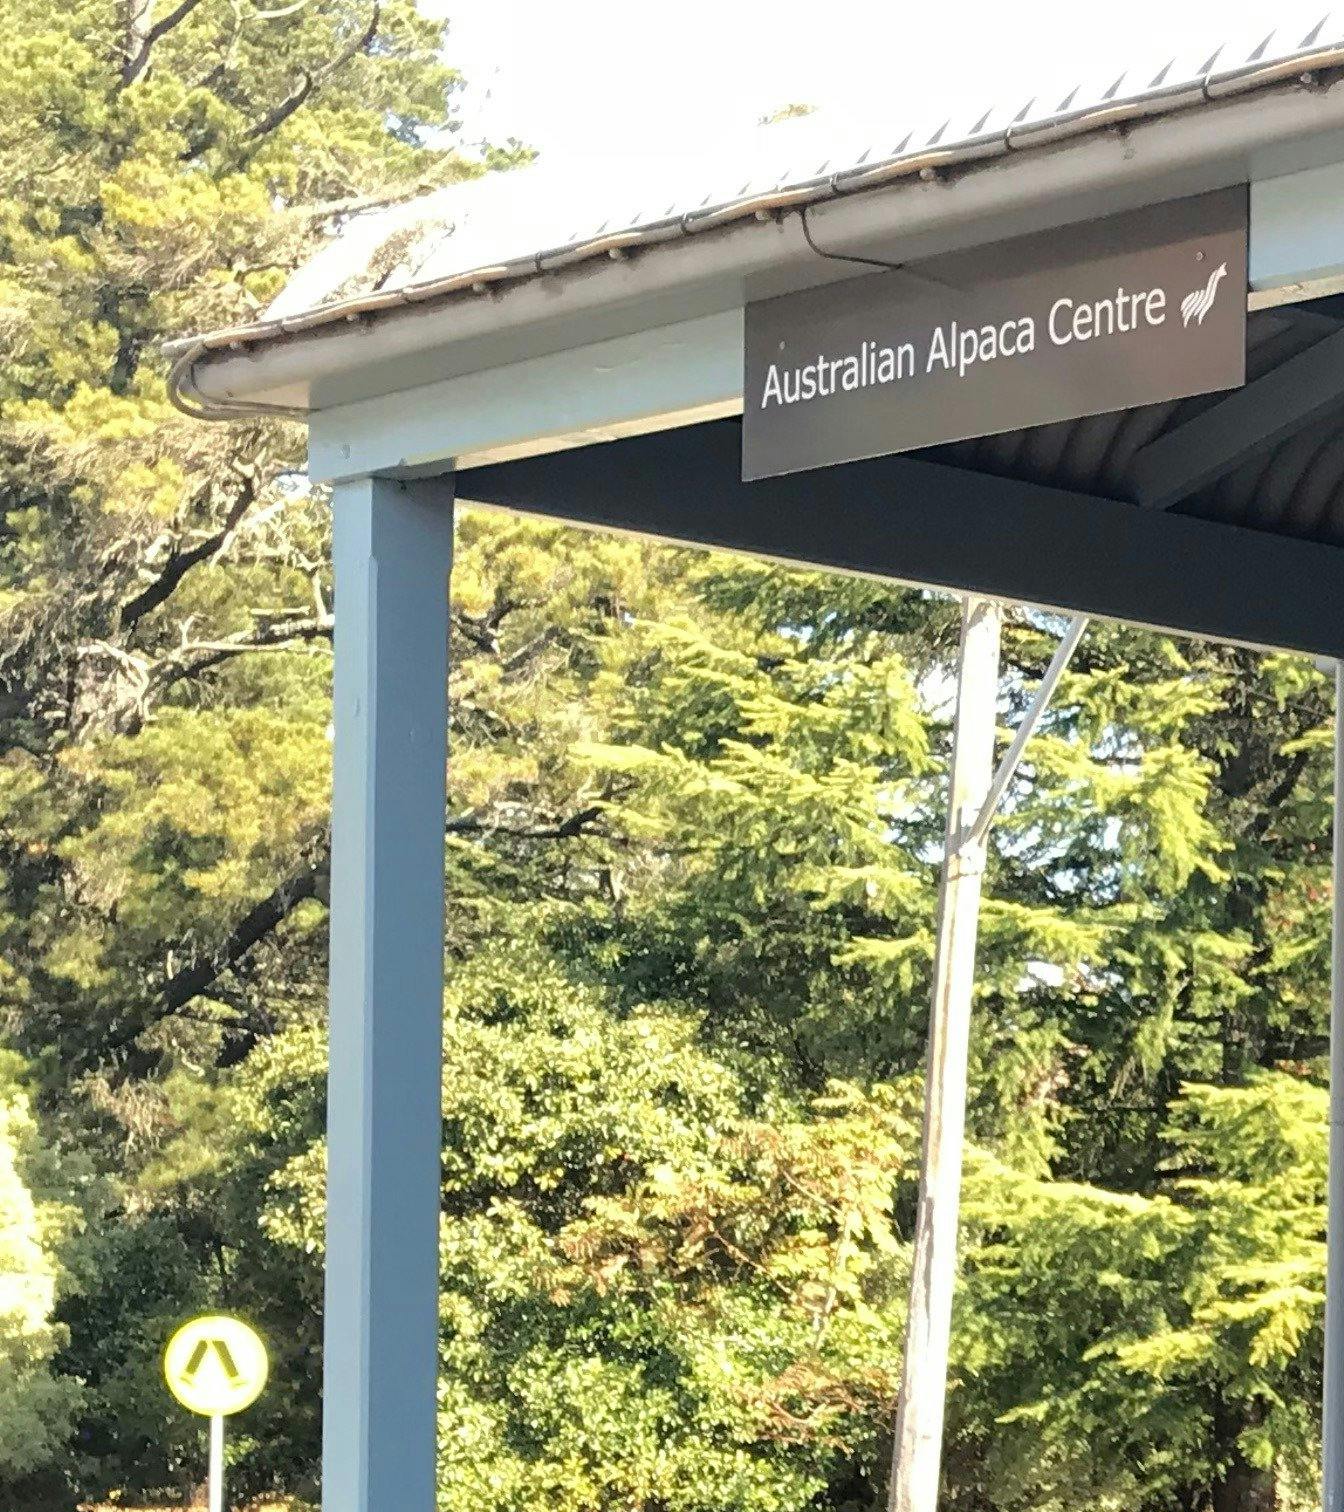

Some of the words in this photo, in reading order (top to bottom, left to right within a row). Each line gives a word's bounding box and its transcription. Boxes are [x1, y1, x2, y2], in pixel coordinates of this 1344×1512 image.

[761, 341, 915, 409] Australian
[925, 317, 1035, 377] Alpaca
[1048, 285, 1166, 348] Centre
